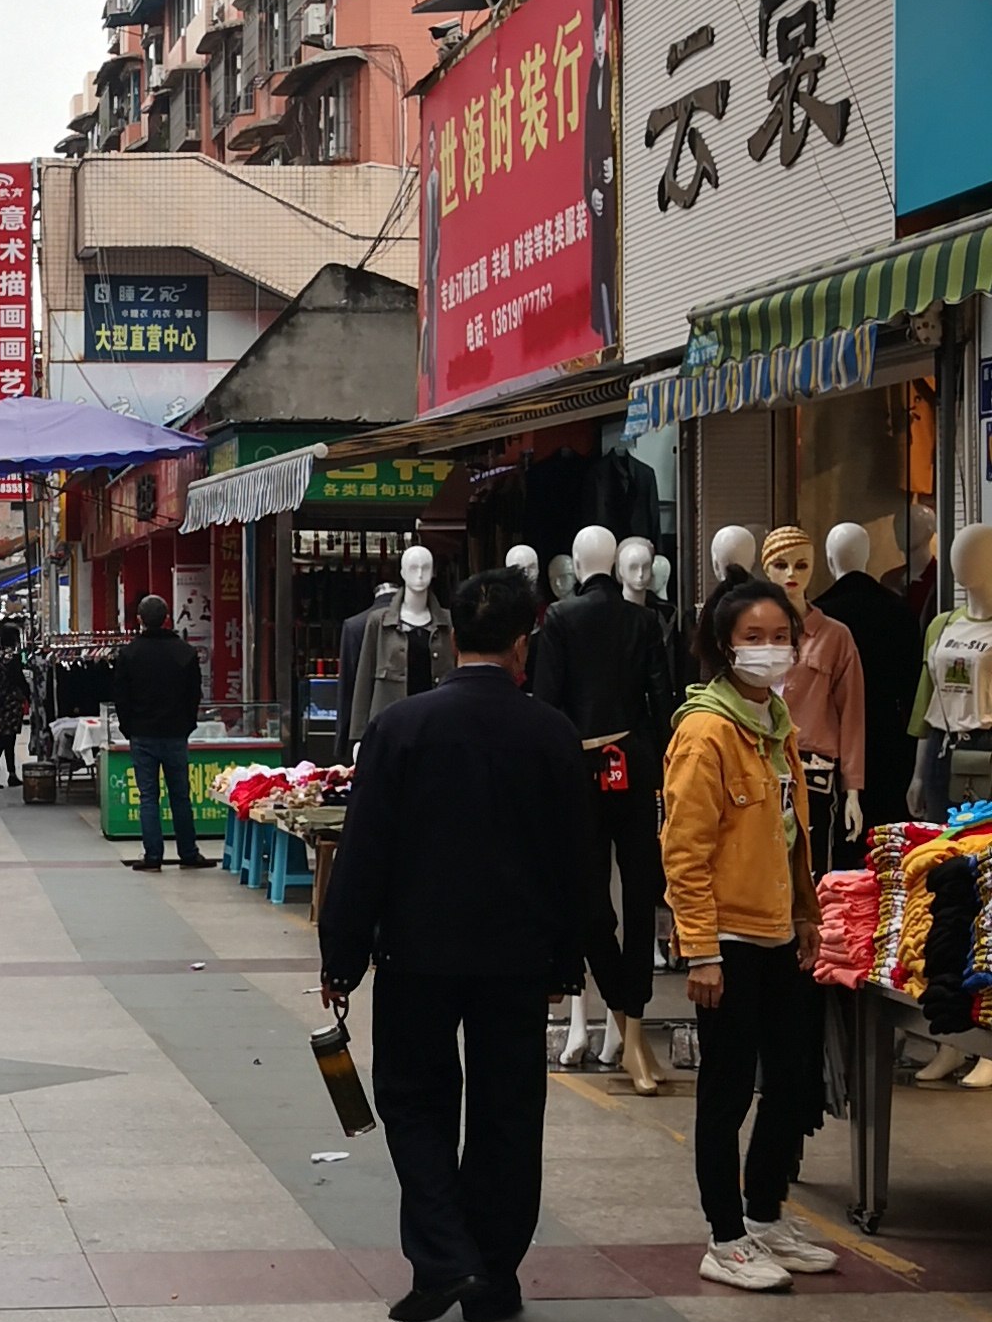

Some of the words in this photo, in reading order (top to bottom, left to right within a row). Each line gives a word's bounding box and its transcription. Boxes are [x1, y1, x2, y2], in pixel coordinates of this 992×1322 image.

[439, 9, 584, 218] 世海时装行
[95, 323, 197, 352] 大型直营中心
[323, 483, 434, 497] 各类缅甸玛瑙
